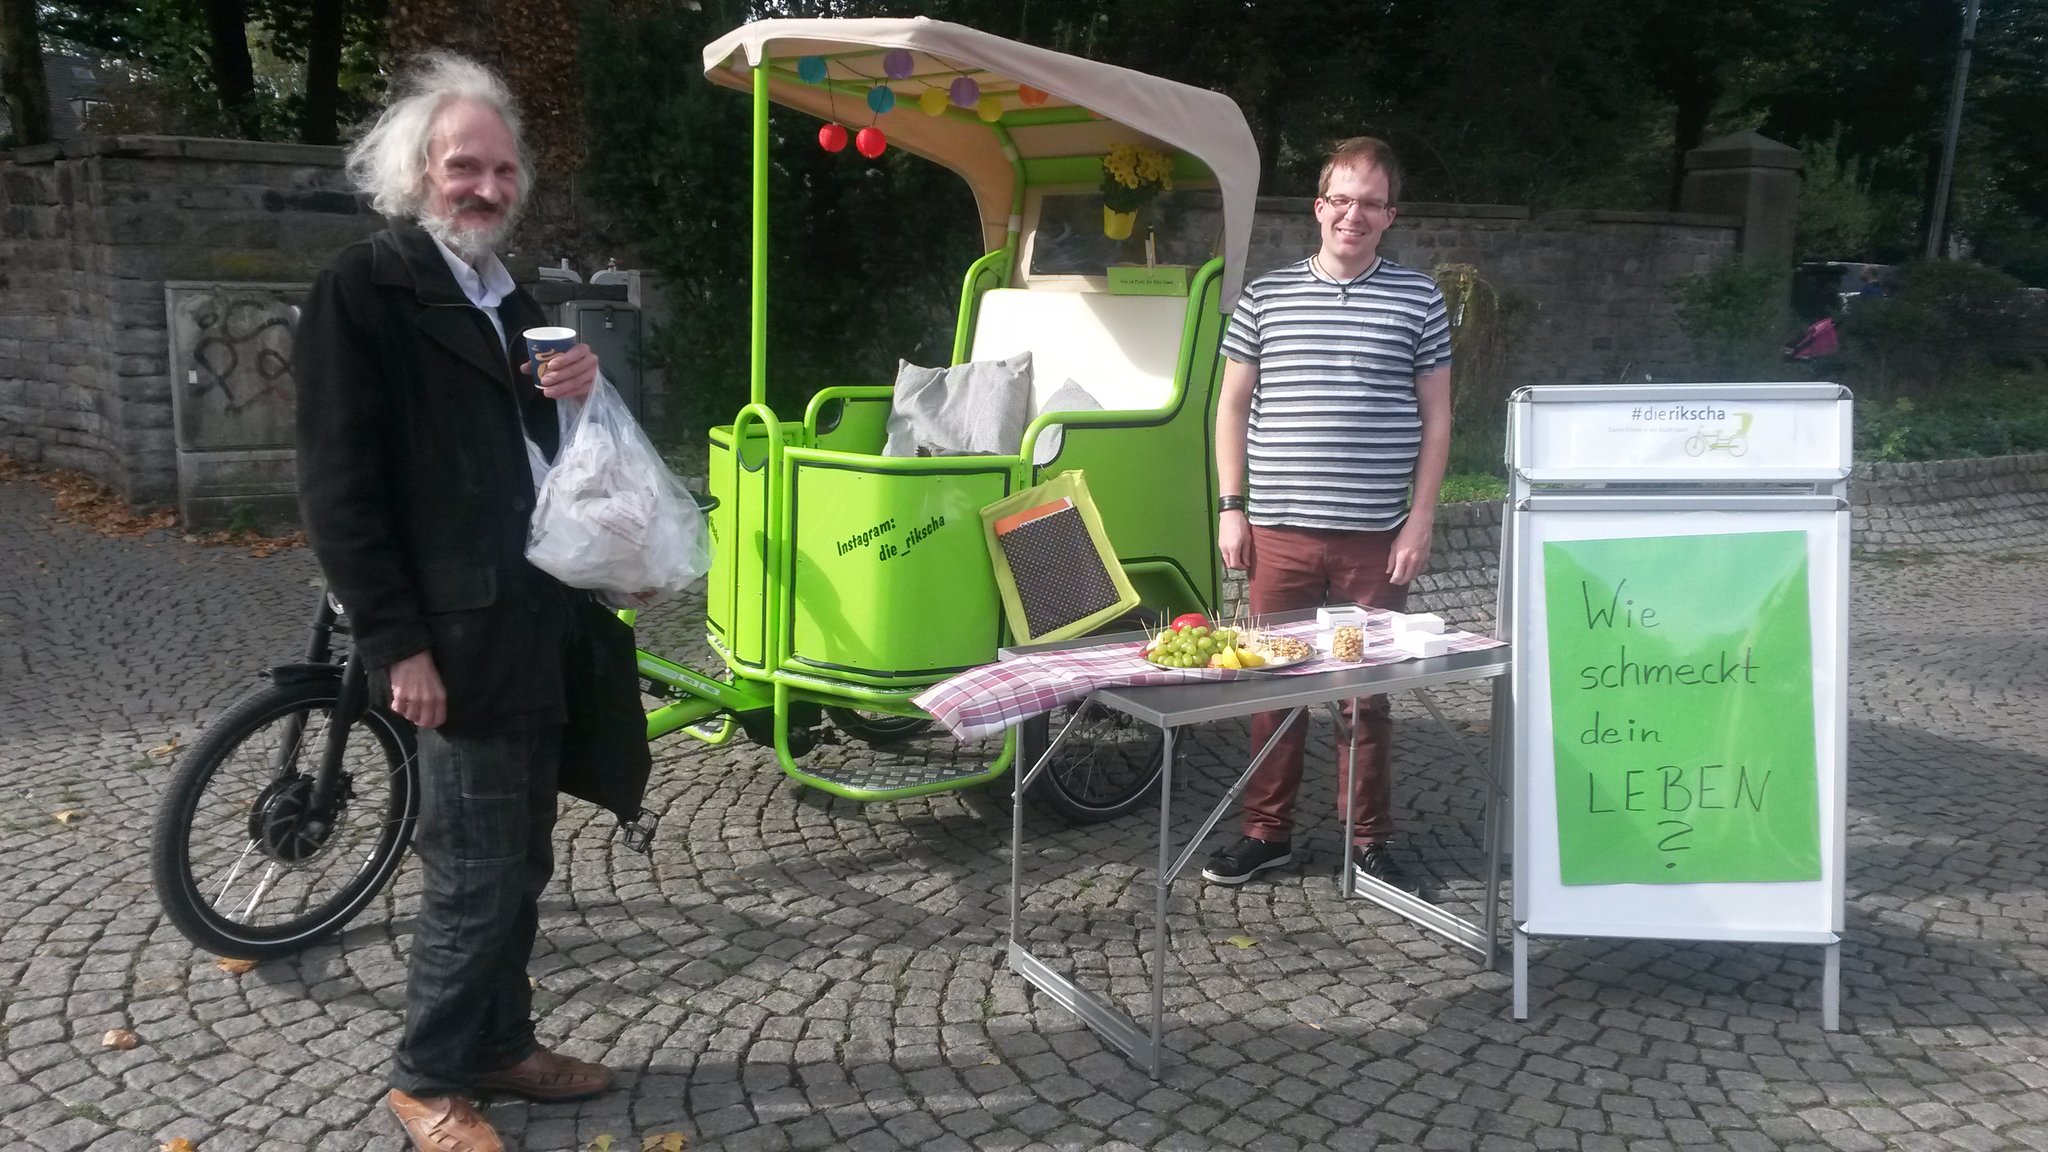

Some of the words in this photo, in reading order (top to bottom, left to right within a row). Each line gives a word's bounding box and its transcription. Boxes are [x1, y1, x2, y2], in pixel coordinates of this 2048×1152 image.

[1632, 405, 1726, 421] #dierikscha
[836, 517, 896, 557] Instagram:
[1581, 578, 1661, 630] Wie
[1580, 645, 1761, 690] schmeckt
[1580, 710, 1663, 745] dein
[1588, 764, 1773, 813] LEBEN
[1656, 819, 1695, 869] ?
